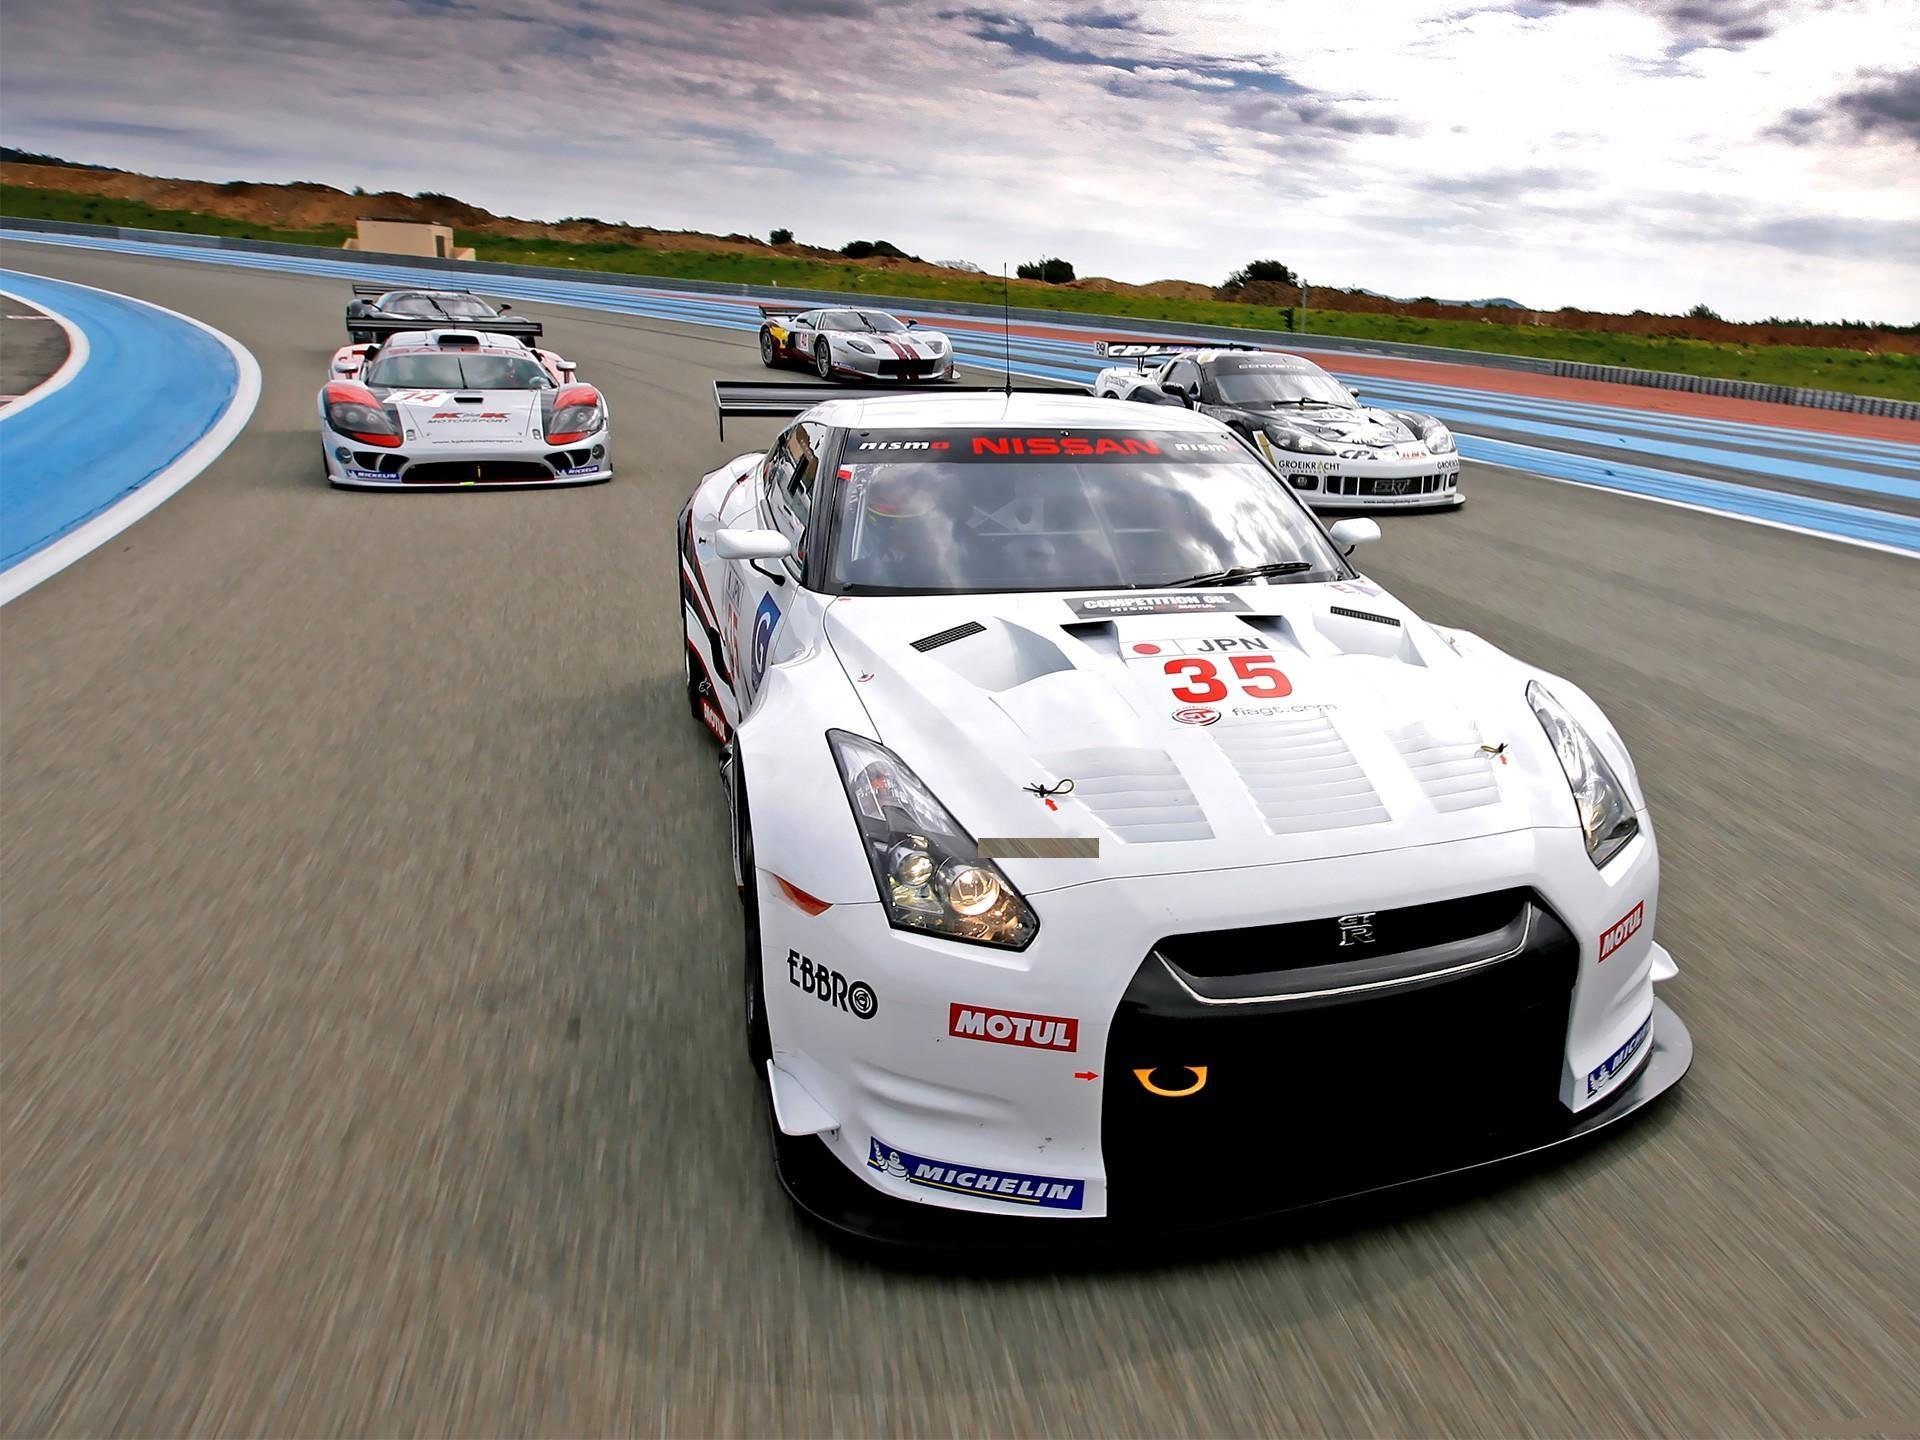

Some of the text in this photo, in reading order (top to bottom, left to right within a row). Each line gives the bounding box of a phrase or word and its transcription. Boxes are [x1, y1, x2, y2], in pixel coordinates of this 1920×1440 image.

[1109, 345, 1161, 356] CPL
[859, 441, 951, 452] nismo
[972, 437, 1162, 456] NISSAN
[1083, 594, 1231, 610] COMPETITION OIL
[1197, 637, 1270, 652] JPN
[1163, 655, 1293, 703] 35
[703, 702, 727, 742] MOTUL
[1601, 907, 1643, 957] MOTUL
[787, 948, 878, 1020] EBBRO
[954, 1010, 1071, 1047] MOTUL
[914, 1163, 1074, 1201] MICHELIN
